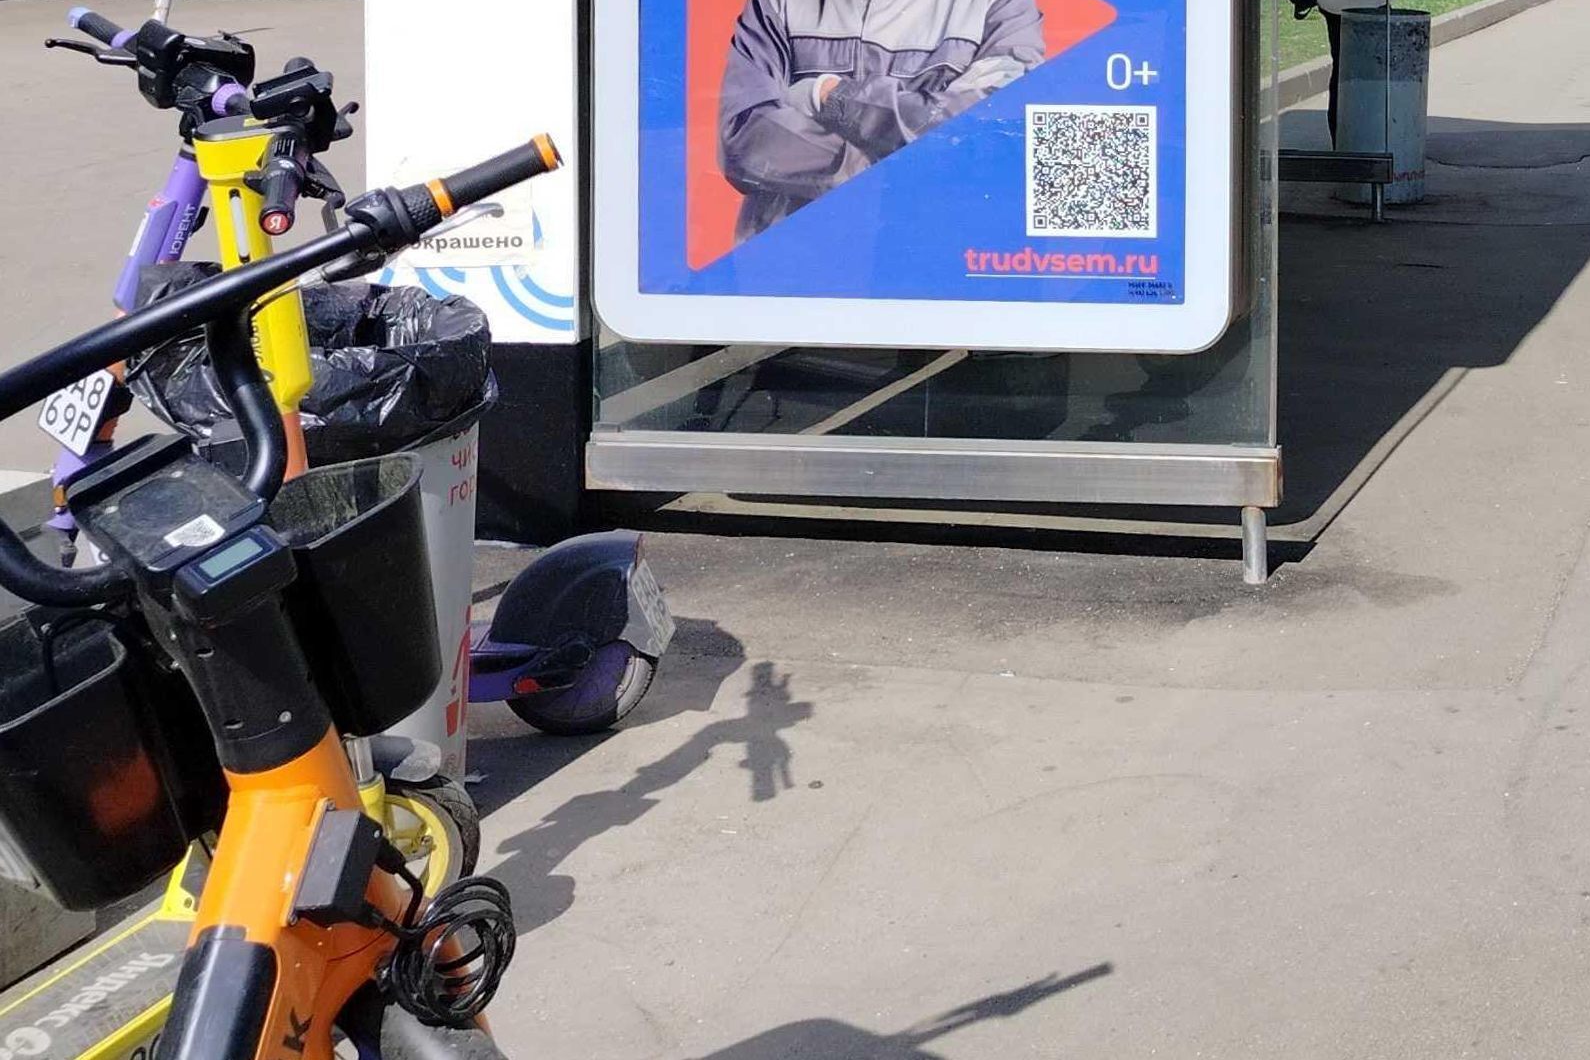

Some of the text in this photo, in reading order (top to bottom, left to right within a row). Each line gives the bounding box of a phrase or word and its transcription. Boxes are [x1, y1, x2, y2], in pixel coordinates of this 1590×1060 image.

[1106, 53, 1158, 90] 0+
[168, 203, 196, 255] ЮРЕНТ
[965, 248, 1158, 274] trudvsem.ru
